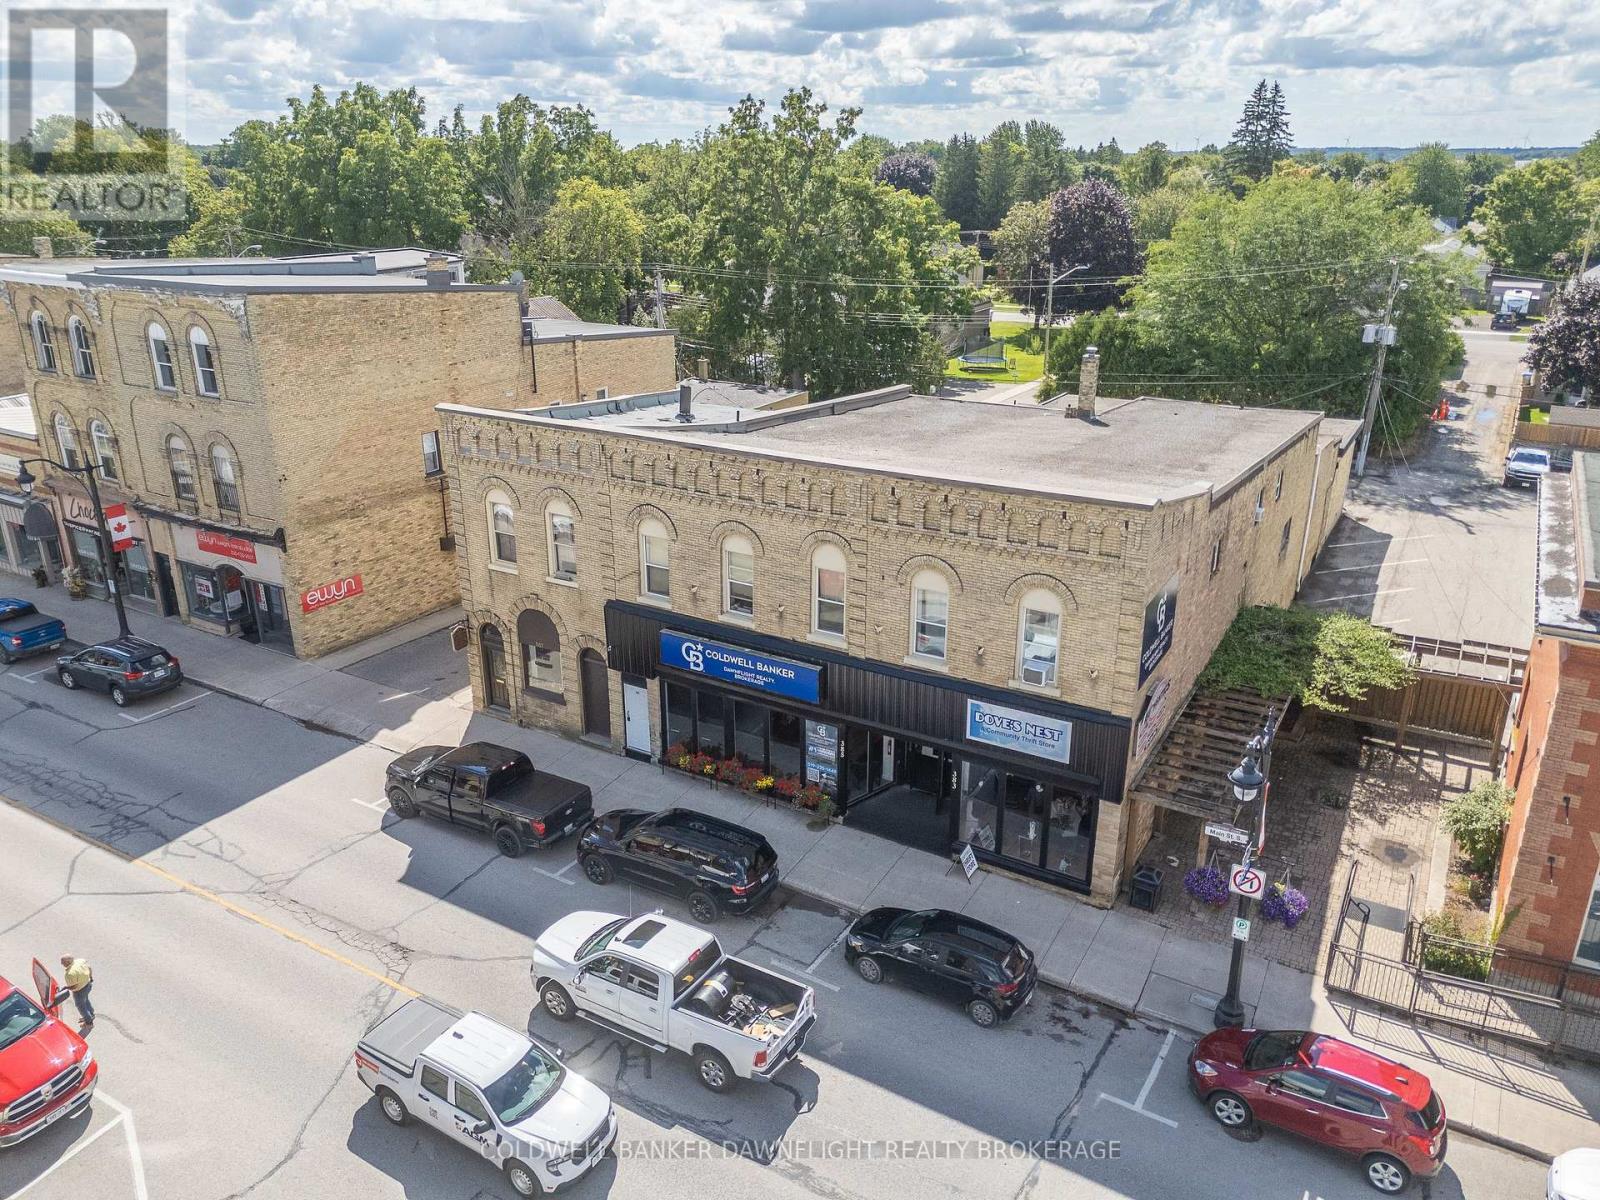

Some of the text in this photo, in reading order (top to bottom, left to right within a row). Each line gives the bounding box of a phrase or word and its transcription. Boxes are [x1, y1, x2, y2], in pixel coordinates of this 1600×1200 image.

[306, 577, 357, 605] ewyn
[705, 649, 795, 679] COLDWELL BANKER
[975, 710, 1064, 743] DOVE'S NEST
[986, 728, 1021, 742] Community
[1021, 735, 1038, 746] Thrift
[1038, 739, 1055, 750] Store
[1209, 828, 1225, 838] Main
